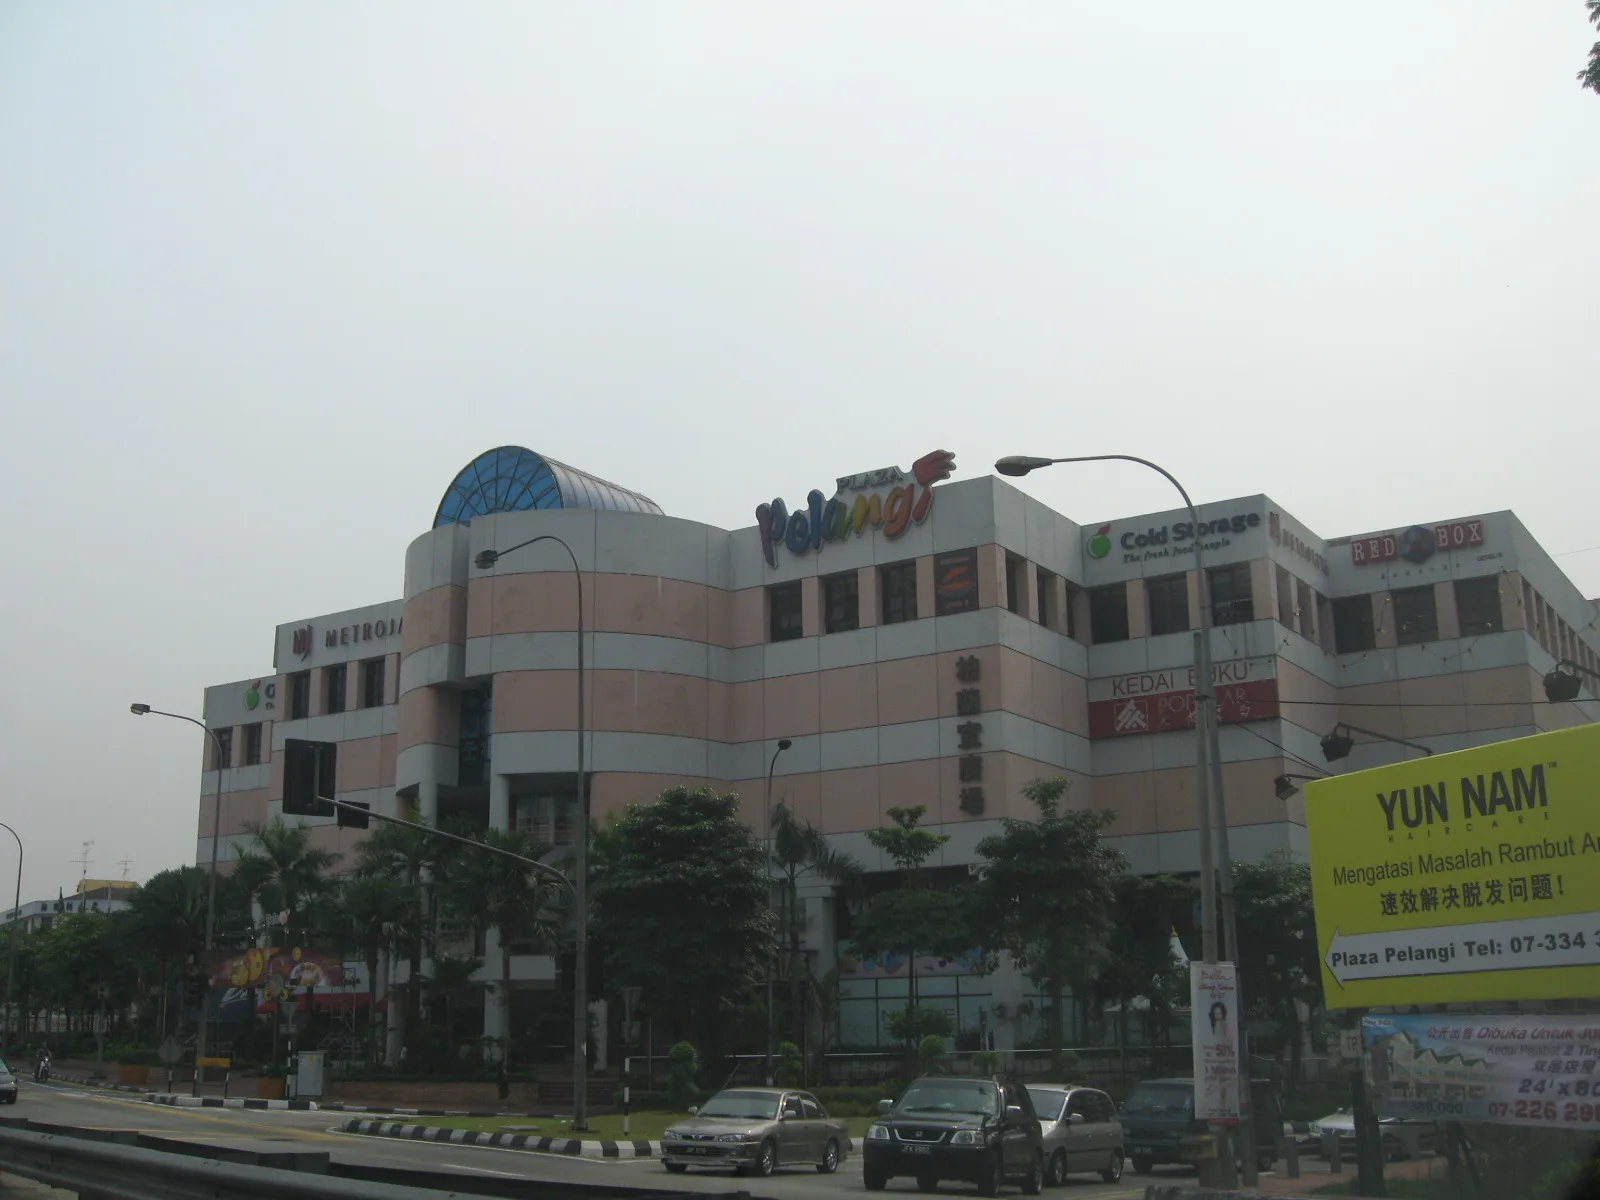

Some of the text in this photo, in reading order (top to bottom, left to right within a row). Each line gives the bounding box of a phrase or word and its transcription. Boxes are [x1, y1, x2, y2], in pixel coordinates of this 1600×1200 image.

[838, 467, 901, 492] PLAZA
[1121, 513, 1260, 550] Cold Storage
[1353, 523, 1481, 561] RED BOX
[1113, 672, 1173, 696] KEDAI
[1376, 782, 1449, 831] YUN
[1460, 764, 1548, 819] NAM
[1333, 863, 1413, 886] Mengatasi
[1418, 849, 1493, 876] Masalah
[1499, 834, 1574, 865] Rambut
[1331, 952, 1378, 968] Plaza
[1385, 942, 1455, 963] Pelangi
[1463, 938, 1502, 958] Tel:
[1510, 932, 1586, 954] 07-334
[1477, 1027, 1527, 1040] Dibuka
[1564, 1044, 1574, 1056] 2
[1488, 1101, 1557, 1121] 07-226
